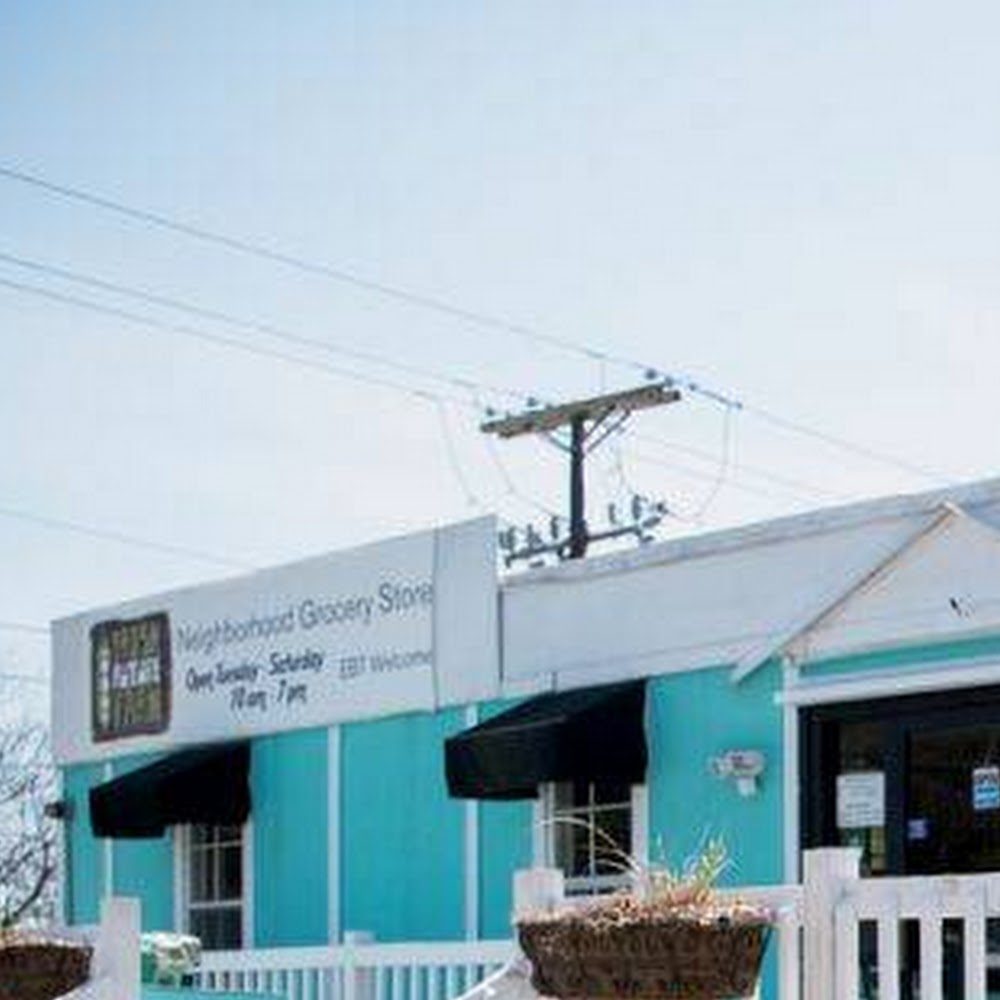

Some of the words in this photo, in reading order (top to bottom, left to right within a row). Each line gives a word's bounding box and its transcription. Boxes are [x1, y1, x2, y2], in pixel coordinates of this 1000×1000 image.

[177, 606, 294, 655] Neighborhood
[299, 597, 373, 629] Grocery
[379, 582, 433, 612] Store
[269, 649, 324, 675] Saturday
